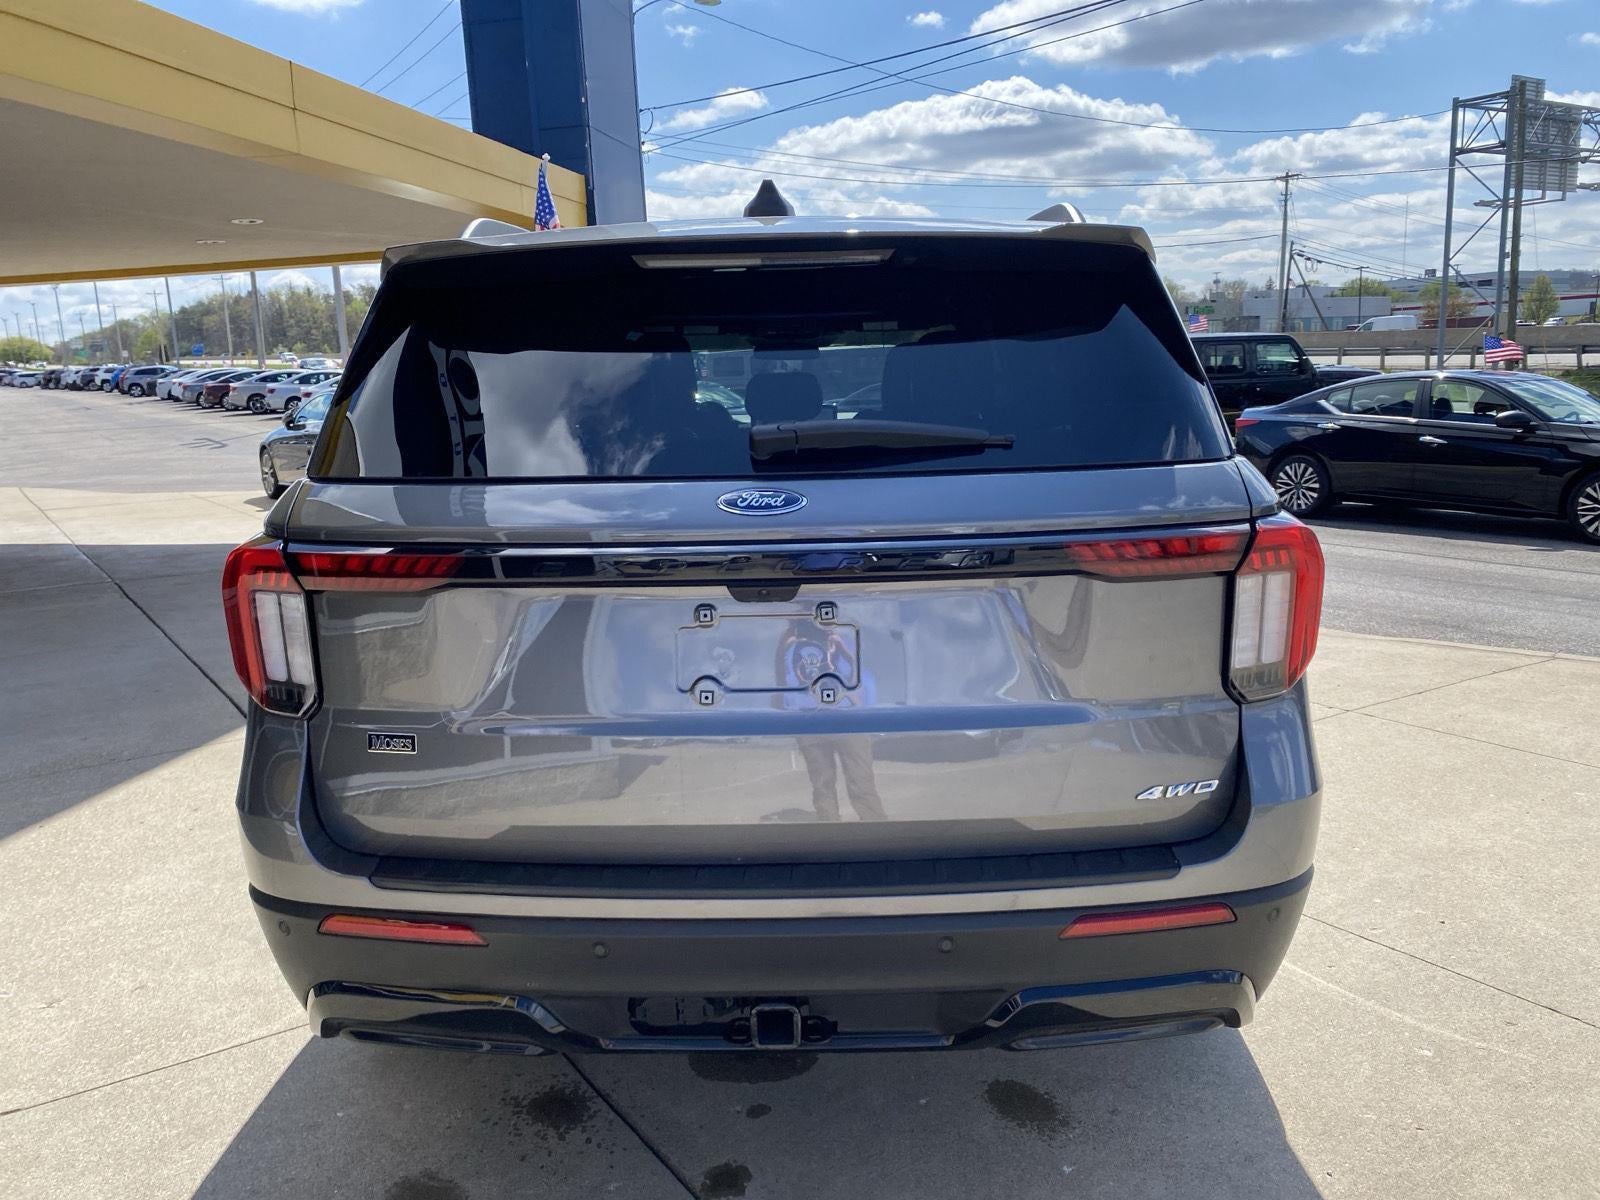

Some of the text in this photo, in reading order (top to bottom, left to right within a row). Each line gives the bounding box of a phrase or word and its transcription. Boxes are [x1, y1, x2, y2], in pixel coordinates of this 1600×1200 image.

[736, 491, 786, 507] Ford
[370, 735, 413, 751] MOSES
[1135, 779, 1220, 800] 4WD
